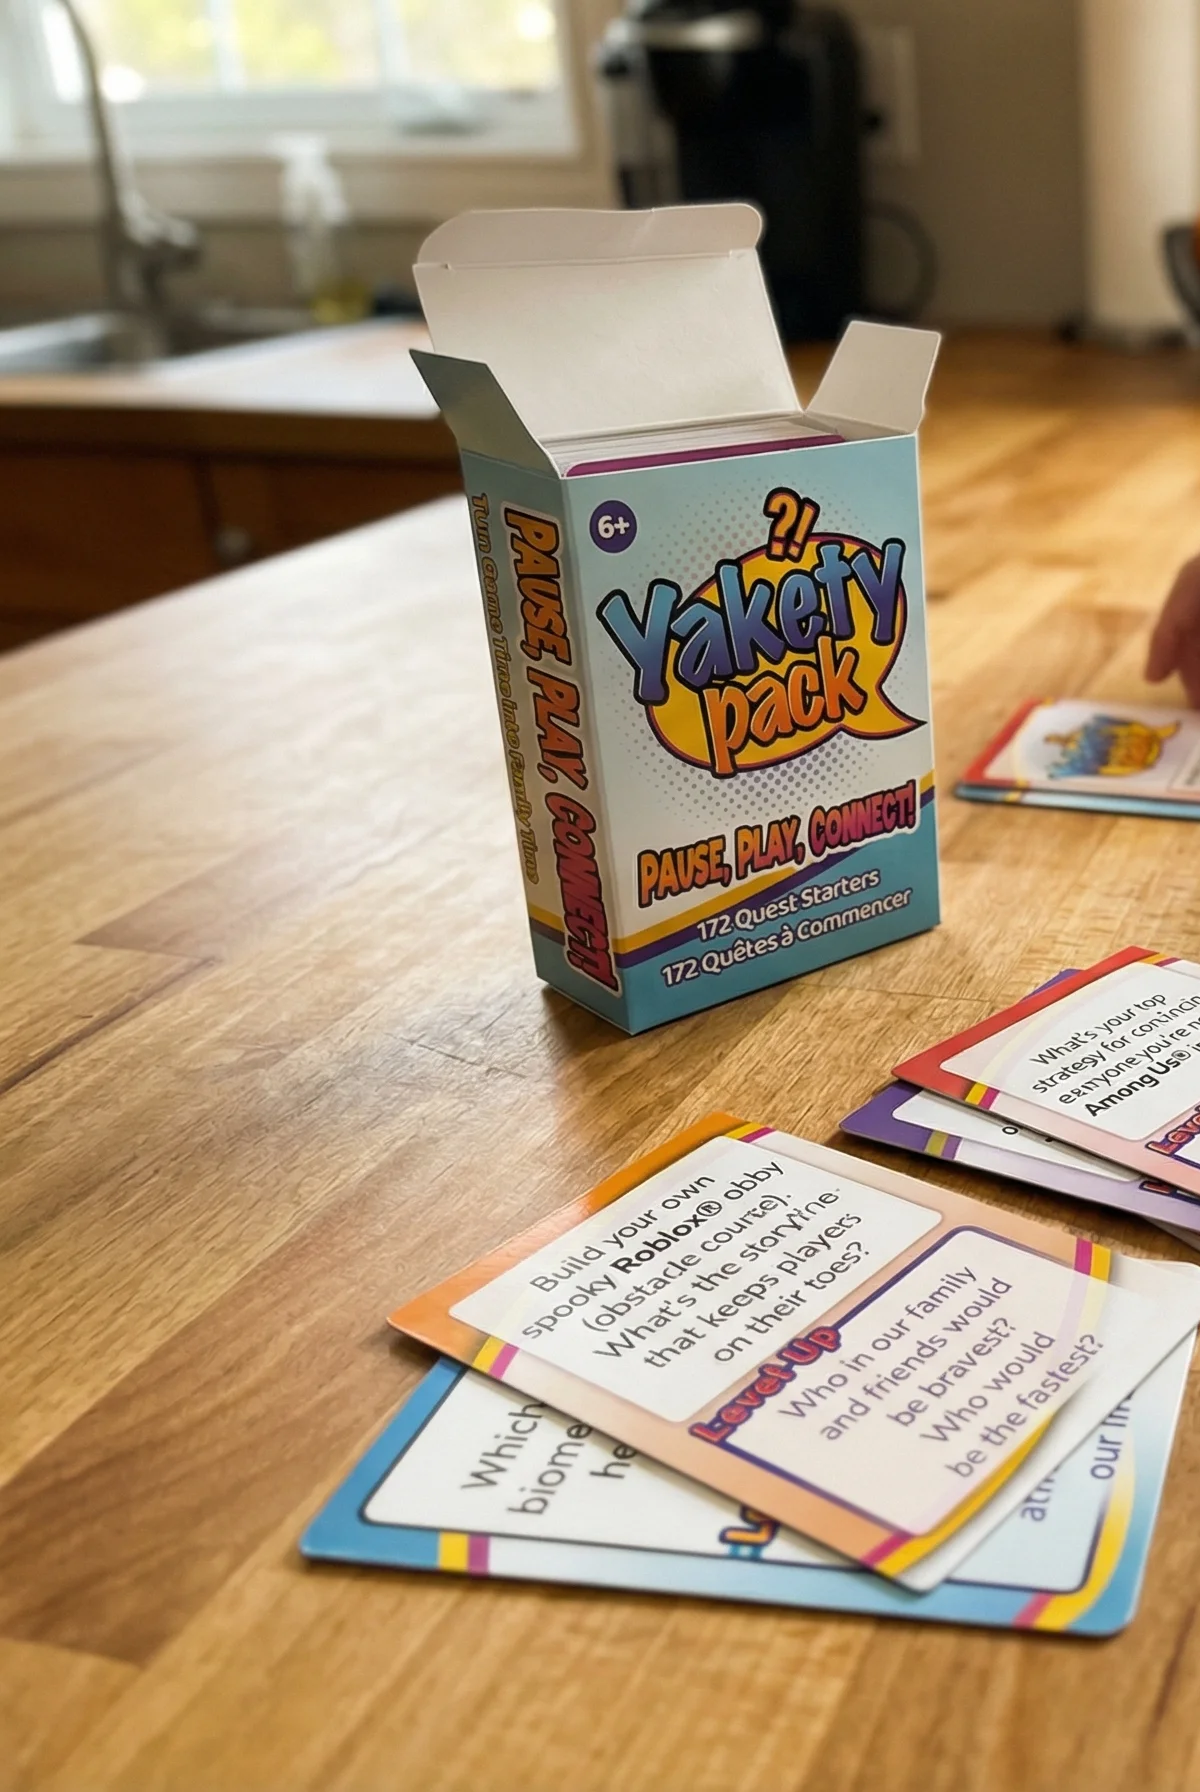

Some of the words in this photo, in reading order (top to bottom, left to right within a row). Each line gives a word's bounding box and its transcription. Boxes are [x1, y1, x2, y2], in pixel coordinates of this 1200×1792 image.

[598, 515, 630, 540] 6+
[504, 507, 572, 667] PAUSE,
[596, 537, 906, 707] Yakety
[526, 666, 589, 790] PLAY,
[699, 633, 868, 779] pack
[545, 792, 619, 992] CONNECT!
[637, 834, 732, 909] PAUSE,
[735, 814, 806, 880] PLAY,
[808, 779, 917, 855] CONNECT!
[661, 958, 700, 987] 172
[701, 934, 779, 975] Quêtes
[780, 925, 794, 947] à
[796, 889, 912, 941] Commencer
[697, 915, 734, 942] 172
[734, 894, 798, 930] Quest
[800, 869, 880, 909] Starters
[1030, 1030, 1098, 1065] What's
[1095, 1008, 1136, 1035] your
[1134, 992, 1166, 1013] top
[1032, 1050, 1107, 1094] strategy
[1101, 1035, 1132, 1053] for
[1136, 1029, 1191, 1062] you're
[1084, 1072, 1160, 1117] Among
[522, 1273, 619, 1339] spooky
[610, 1200, 722, 1274] Roblox®
[723, 1160, 785, 1201] obby
[530, 1246, 606, 1293] Build
[602, 1209, 658, 1250] your
[662, 1176, 715, 1212] own
[581, 1252, 702, 1332] (obstacle
[643, 1325, 707, 1369] that
[696, 1273, 780, 1328] keeps
[776, 1212, 863, 1276] players
[593, 1295, 698, 1362] What's
[691, 1261, 744, 1293] the
[713, 1335, 754, 1364] on
[745, 1289, 808, 1336] their
[804, 1240, 871, 1291] toes?
[777, 1369, 849, 1422] Who
[840, 1350, 872, 1371] in
[871, 1319, 911, 1352] our
[905, 1265, 979, 1323] family
[820, 1400, 872, 1442] and
[864, 1334, 948, 1402] friends
[942, 1277, 1014, 1335] would
[886, 1399, 928, 1429] be
[922, 1317, 1020, 1400] bravest?
[919, 1394, 989, 1445] Who
[986, 1330, 1057, 1393] would
[945, 1447, 988, 1479] be
[980, 1408, 1029, 1451] the
[1017, 1332, 1105, 1413] fastest?
[460, 1401, 547, 1490] Which
[507, 1422, 593, 1516] biome
[1090, 1434, 1123, 1480] our
